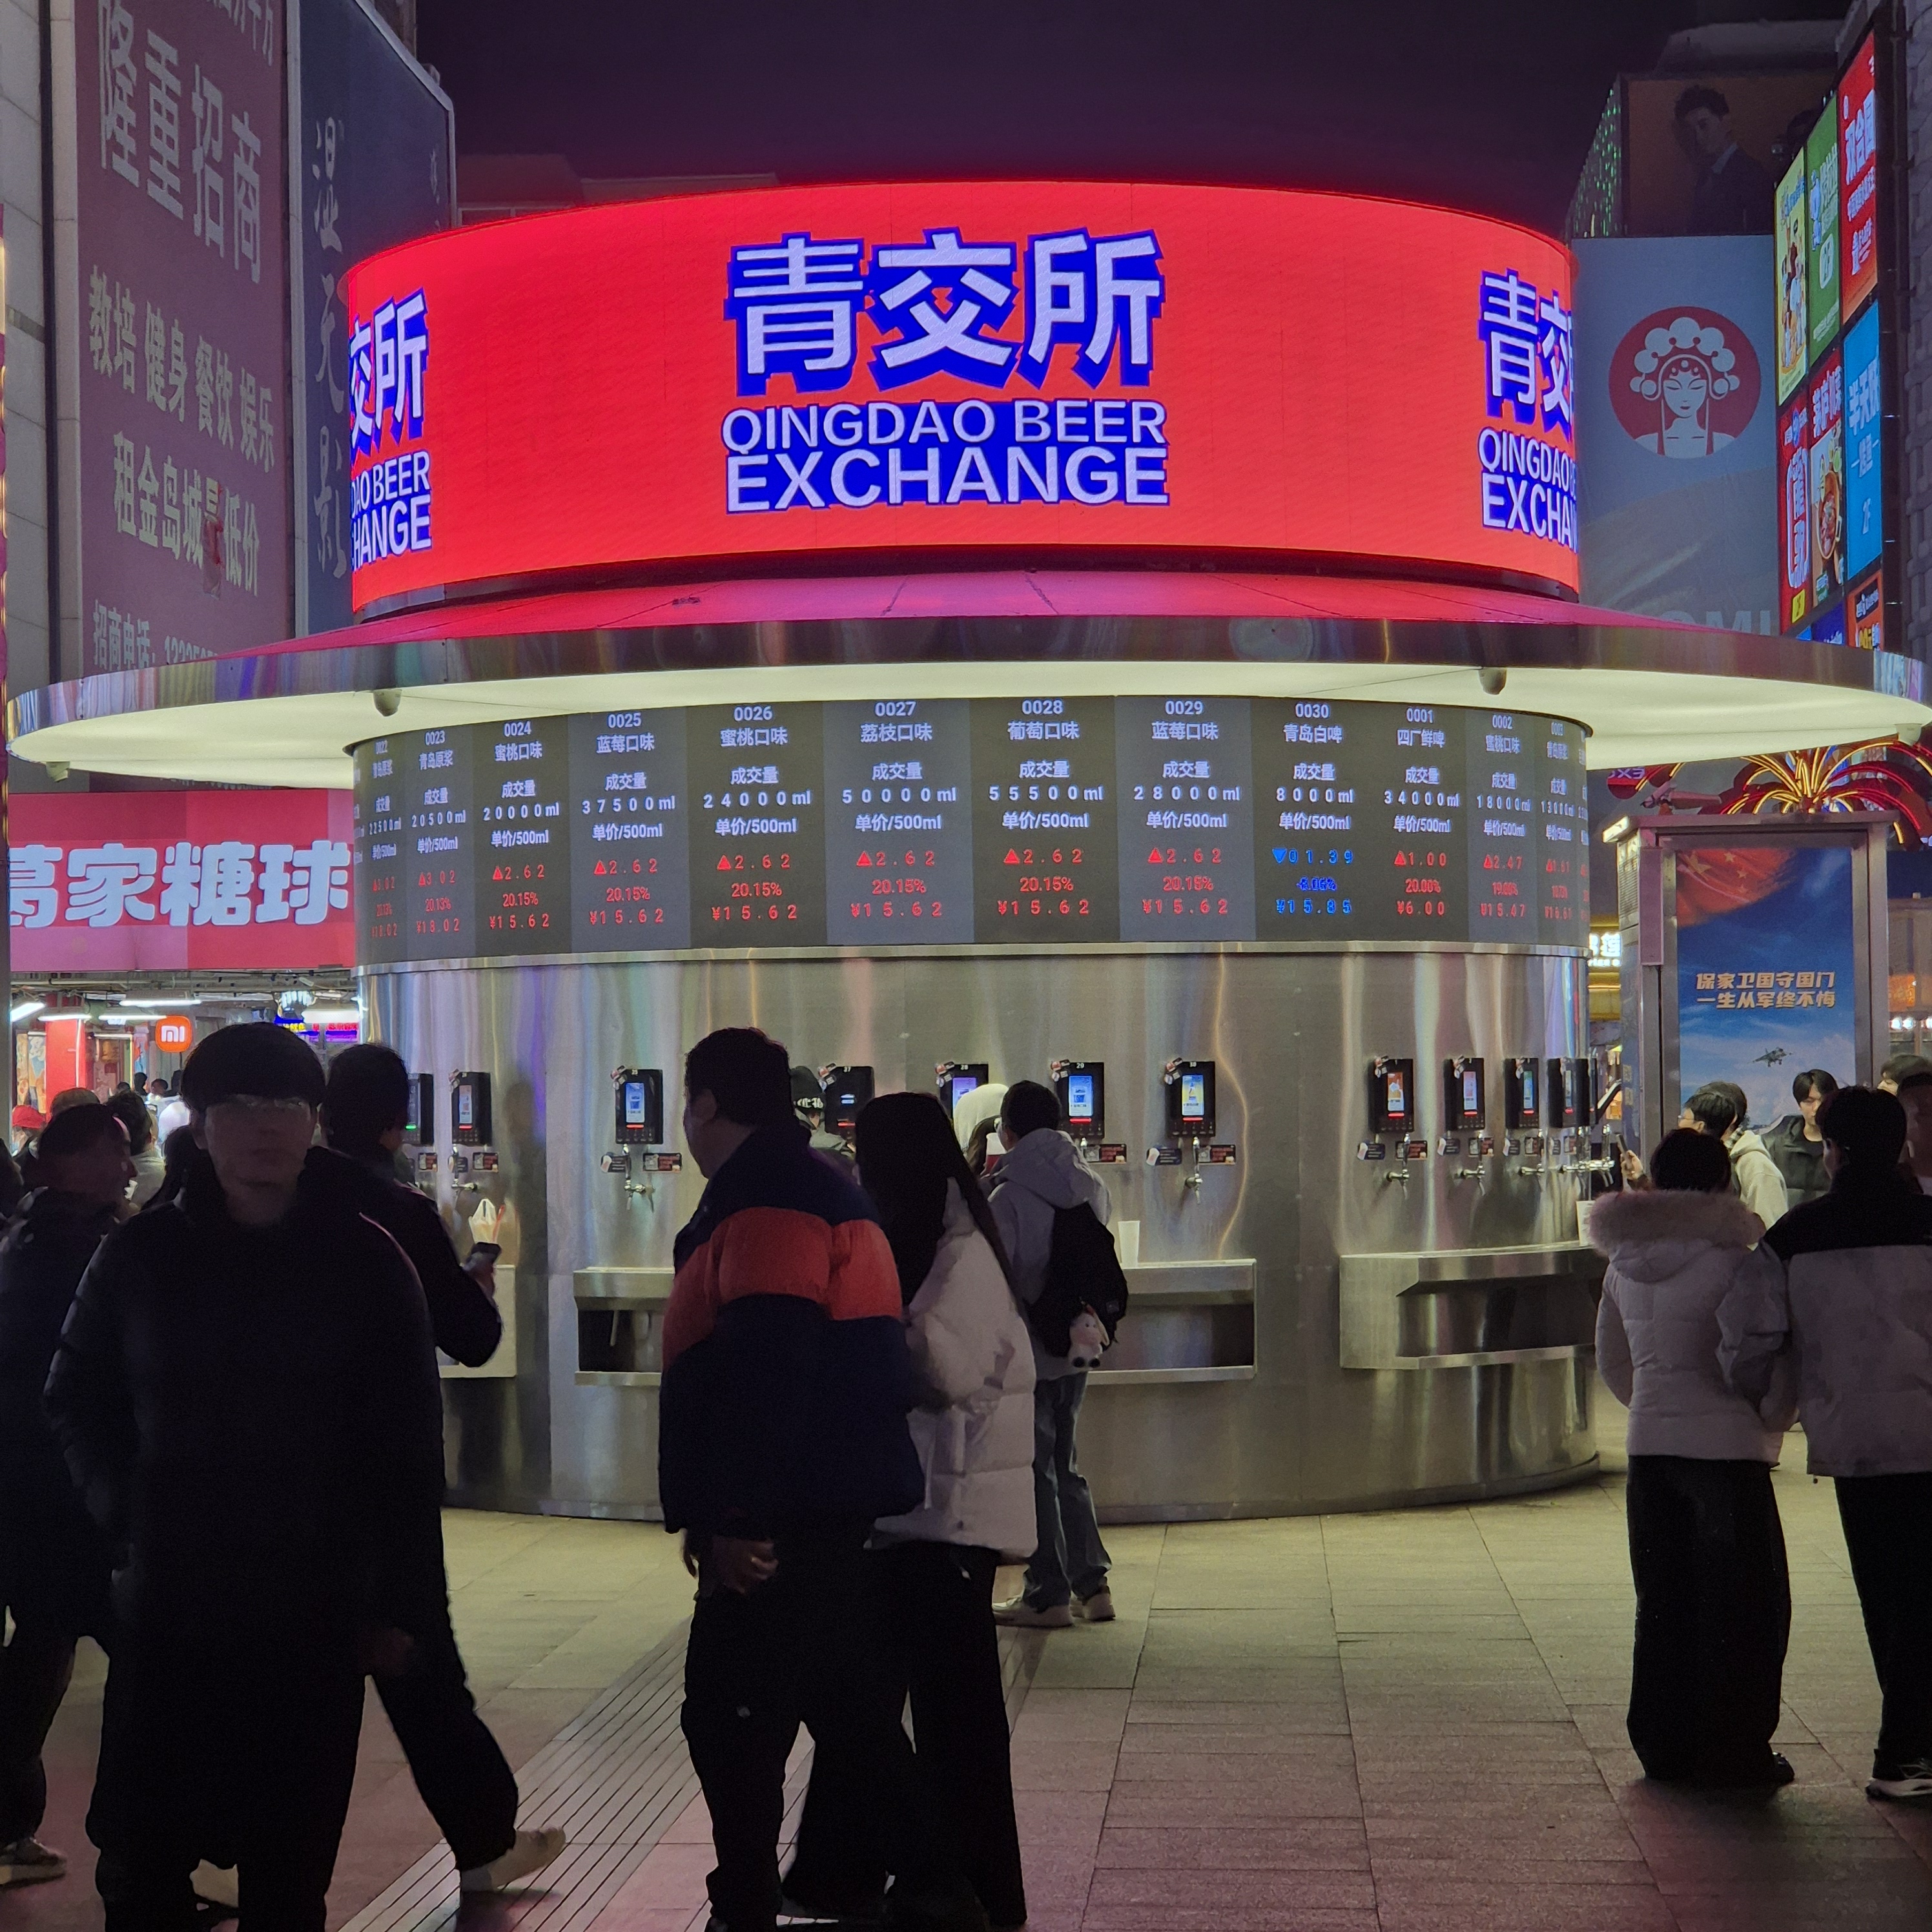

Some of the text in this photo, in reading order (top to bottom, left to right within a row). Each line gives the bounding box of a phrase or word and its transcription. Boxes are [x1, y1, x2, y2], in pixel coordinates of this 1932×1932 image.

[98, 0, 261, 284] 隆重招商
[732, 232, 1161, 375] 青交所
[1483, 274, 1574, 426] 青交
[89, 264, 274, 473] 教培 健身 餐饮 娱乐
[721, 398, 1167, 454] QINGDAO BEER
[1478, 429, 1569, 492] QINGDAO
[373, 451, 430, 504] BEER
[727, 446, 1169, 511] EXCHANGE
[352, 494, 431, 569] HANGE
[734, 706, 773, 721] 0026
[875, 701, 916, 717] 0027
[1022, 699, 1063, 714] 0028
[1165, 701, 1204, 715] 0029
[1295, 703, 1329, 719] 0030
[1406, 708, 1433, 723] 0001
[504, 721, 531, 737] 0024
[608, 712, 641, 728] 0025
[1492, 714, 1513, 730] 0002
[425, 730, 446, 745] 0023
[721, 726, 788, 747] 蜜桃口味
[861, 723, 932, 743] 荔枝口味
[1008, 721, 1080, 740] 葡萄口味
[1151, 721, 1218, 740] 蓝莓口味
[1283, 723, 1342, 743] 青岛白啤
[1397, 729, 1445, 748] 四厂鲜啤
[495, 741, 542, 761] 蜜桃口味
[596, 732, 655, 754] 蓝莓口味
[419, 749, 453, 770] 青岛原浆
[731, 766, 778, 785] 成交量
[872, 762, 923, 780] 成交量
[1020, 760, 1069, 778] 成交量
[1162, 761, 1209, 778] 成交量
[1293, 763, 1335, 781] 成交量
[1405, 766, 1439, 785] 成交量
[502, 779, 535, 798] 成交量
[605, 772, 646, 791] 成交量
[1492, 772, 1516, 790] 成交量
[424, 787, 448, 805] 成交量
[703, 789, 811, 808] 24000ml
[842, 786, 957, 804] 50000ml
[989, 785, 1104, 801] 55500ml
[1133, 785, 1240, 801] 28000ml
[1276, 786, 1355, 803] 8000ml
[1384, 790, 1460, 808] 34000ml
[483, 801, 560, 821] 20000ml
[582, 795, 675, 815] 37500ml
[1477, 794, 1532, 812] 18000ml
[411, 809, 466, 828] 20500ml
[715, 817, 797, 836] 单价/500ml
[855, 813, 941, 832] 单价/500ml
[1002, 811, 1088, 830] 单价/500ml
[1146, 811, 1227, 828] 单价/500ml
[1279, 812, 1350, 830] 单价/500ml
[1393, 815, 1450, 832] 单价/500ml
[491, 829, 549, 847] 单价/500ml
[592, 823, 663, 841] 单价/500ml
[417, 836, 458, 854] 单价/500ml
[735, 854, 790, 871] 2.62
[876, 850, 934, 867] 2.62
[1023, 848, 1082, 865] 2.62
[1166, 848, 1220, 865] 2.62
[504, 864, 544, 881] 2.62
[608, 858, 657, 876] 2.62
[9, 840, 351, 928] 葛家糖球
[732, 883, 782, 898] 20.15%
[872, 879, 925, 895] 20.15%
[1021, 877, 1073, 892] 20.15%
[1163, 876, 1213, 892] 20.15%
[503, 892, 538, 907] 20.15%
[606, 887, 650, 903] 20.15%
[712, 904, 797, 921] ¥15.62
[850, 901, 941, 918] ¥15.62
[998, 899, 1089, 916] ¥15.62
[1142, 899, 1227, 915] ¥15.62
[1397, 901, 1444, 916] ¥6.00
[489, 913, 550, 930] ¥15.62
[590, 908, 663, 925] ¥15.62
[1696, 971, 1835, 990] 保家卫国守国门
[1697, 991, 1836, 1009] 一生从军终不悔
